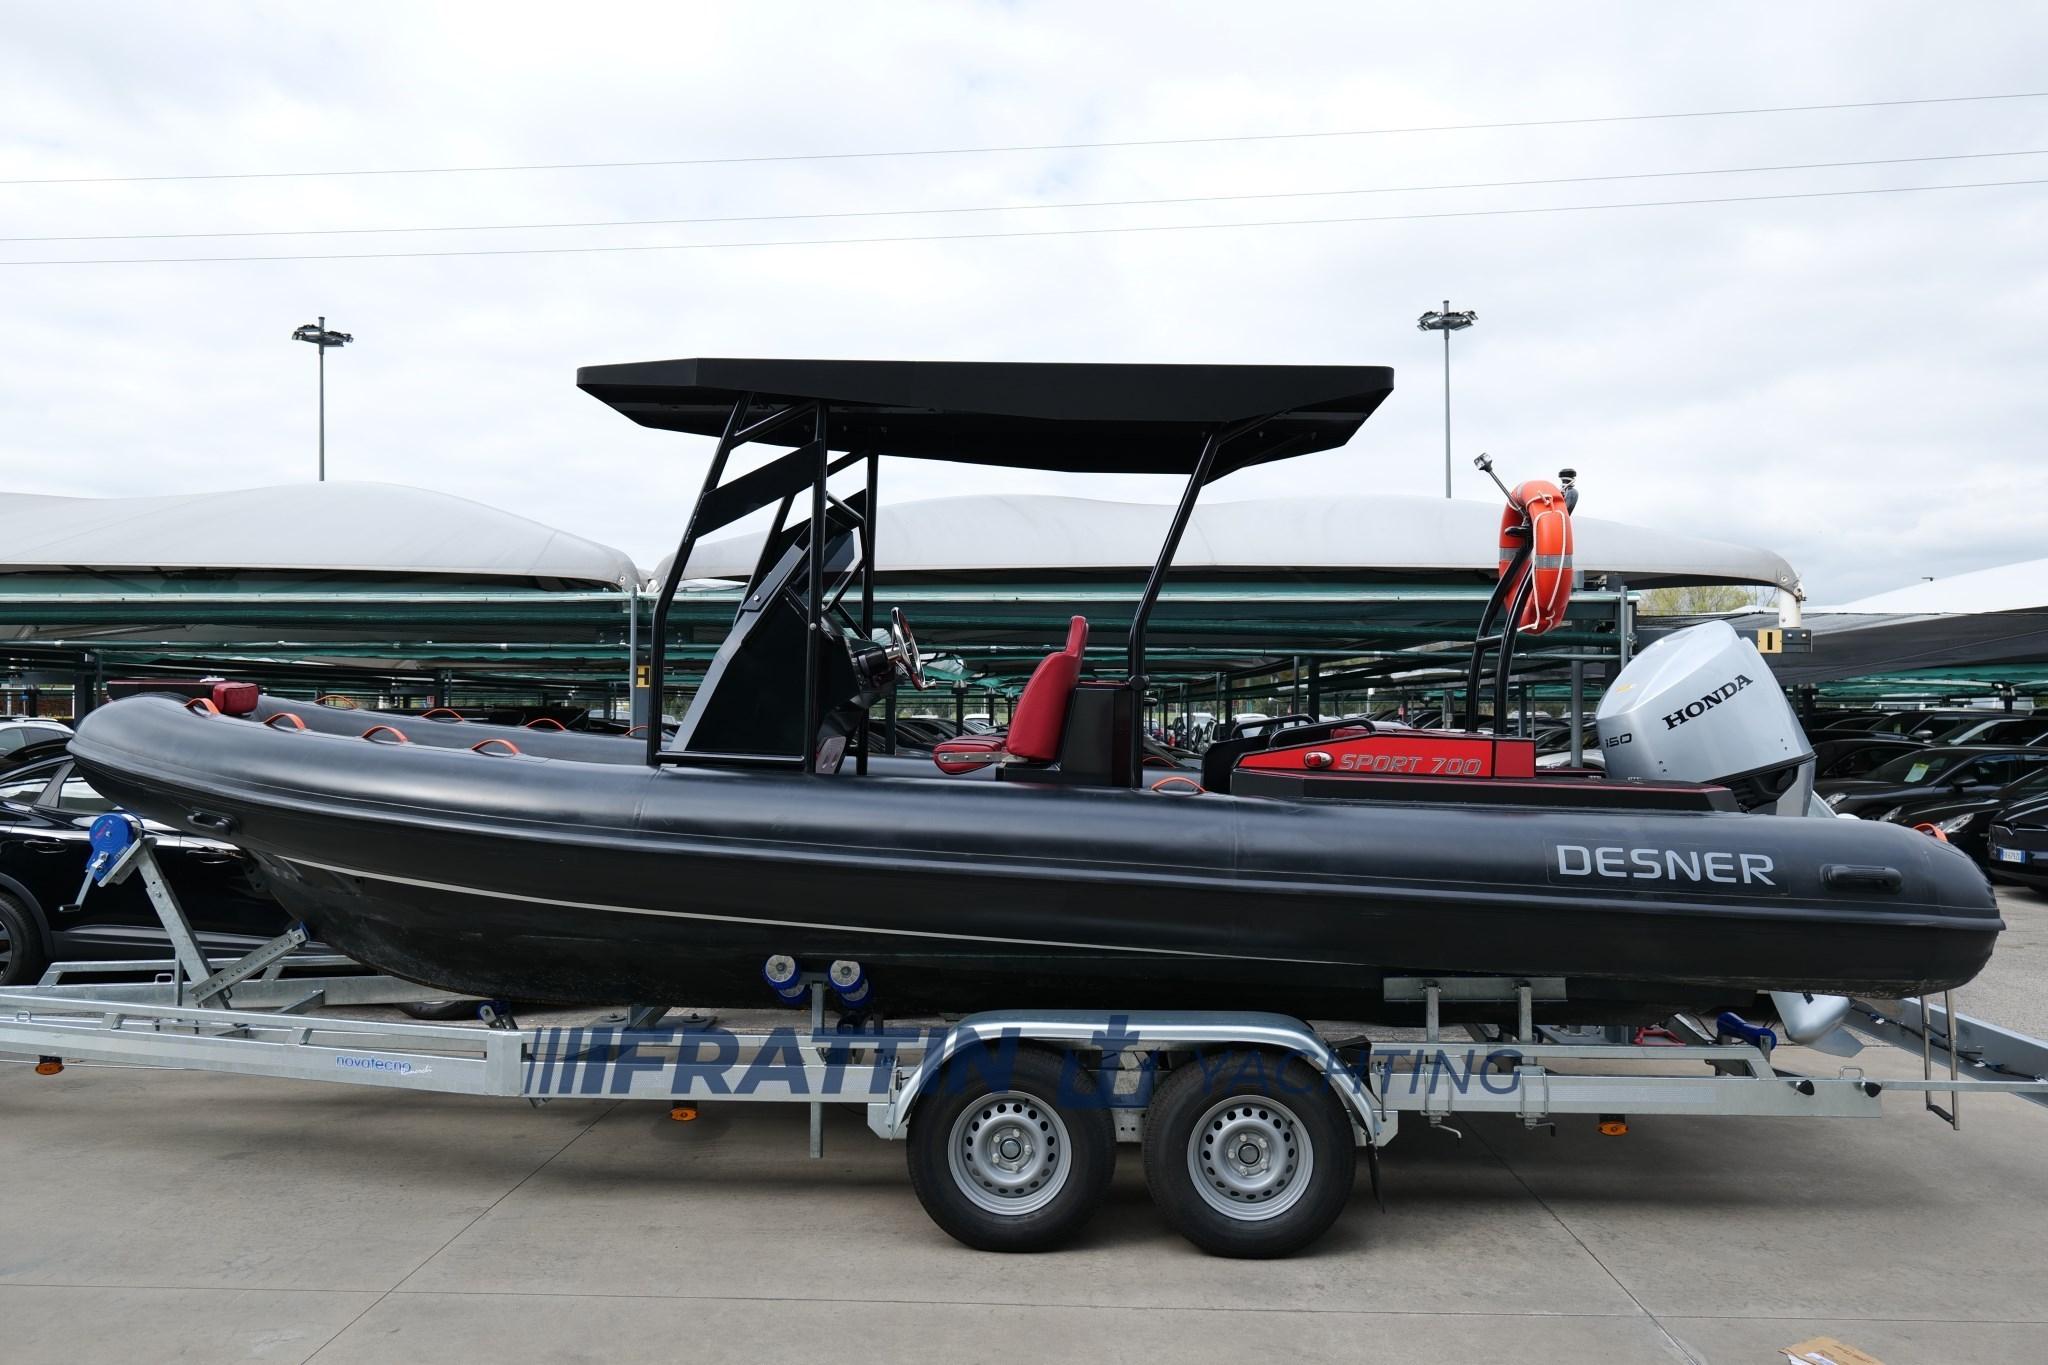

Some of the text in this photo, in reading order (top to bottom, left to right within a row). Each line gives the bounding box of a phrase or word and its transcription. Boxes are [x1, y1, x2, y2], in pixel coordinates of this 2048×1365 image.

[1661, 673, 1754, 731] HONDA
[1604, 732, 1633, 749] 150
[1338, 753, 1482, 776] SPORT 700
[1556, 844, 1777, 886] DESNER
[335, 1055, 412, 1073] novatecno
